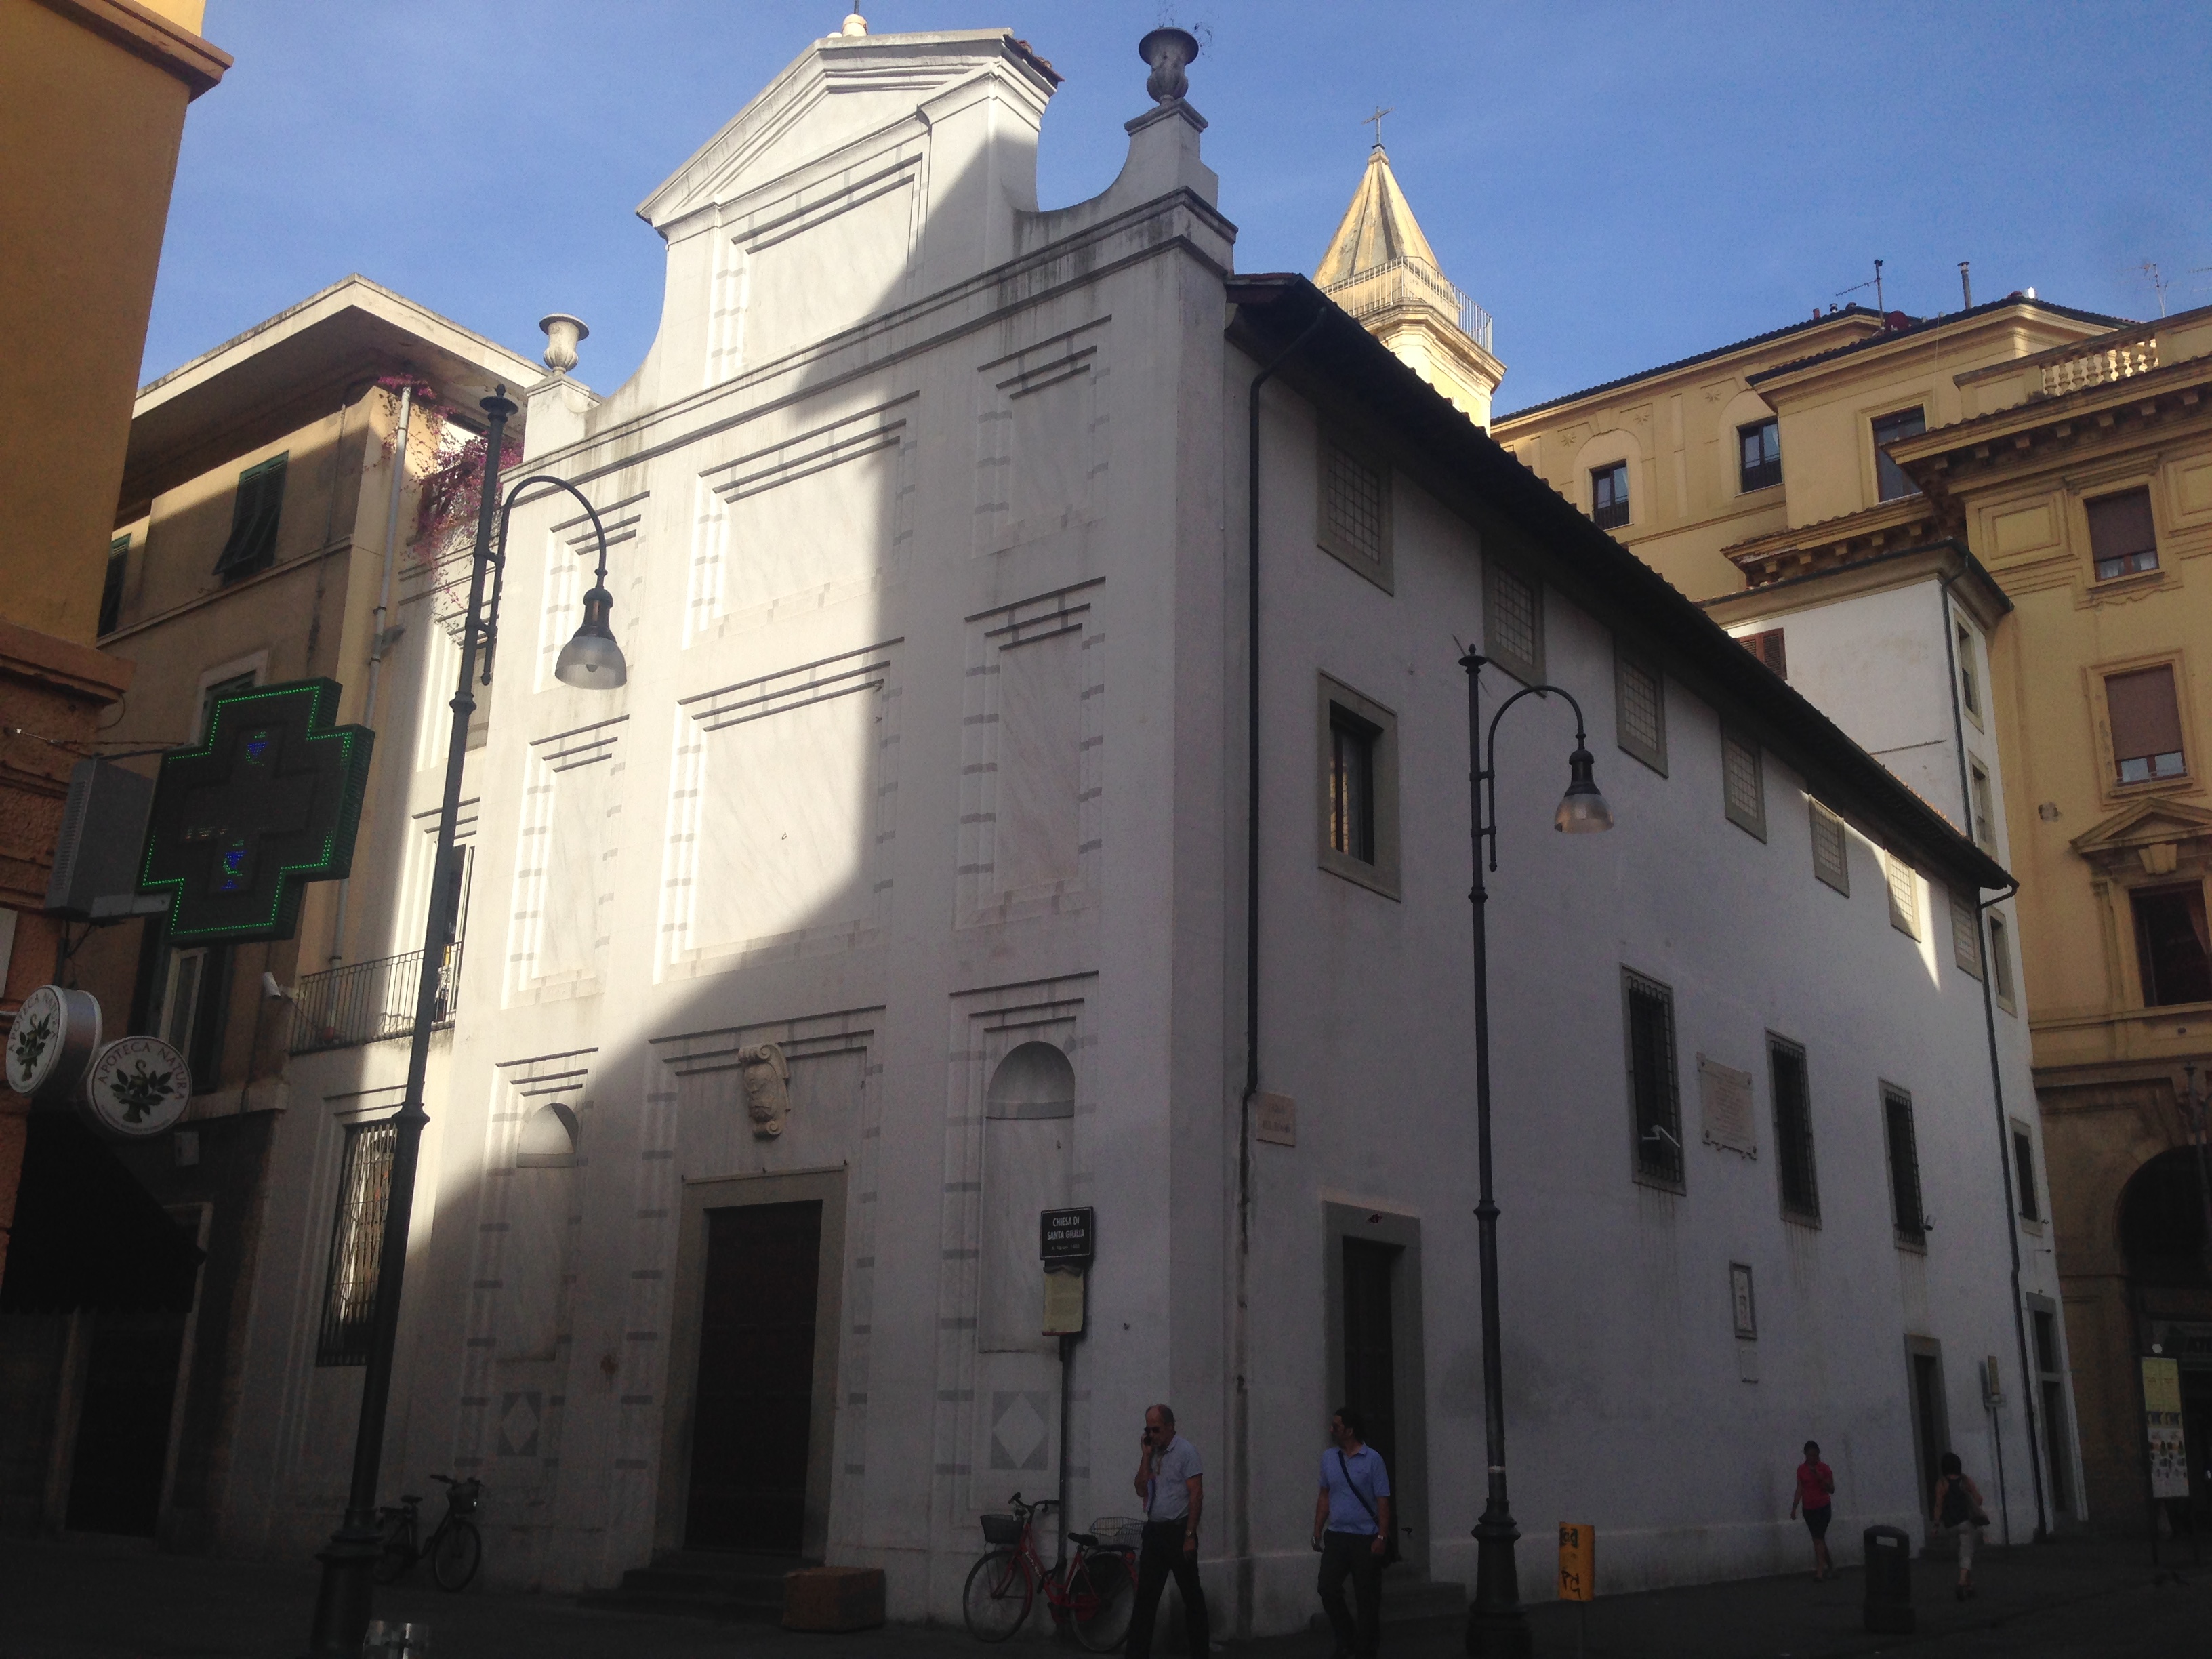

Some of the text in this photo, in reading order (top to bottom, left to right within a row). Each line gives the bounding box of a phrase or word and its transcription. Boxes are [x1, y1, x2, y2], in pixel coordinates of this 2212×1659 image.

[98, 1042, 187, 1099] APOTECA NATURA
[1052, 1215, 1080, 1227] CHIESA DI
[1047, 1229, 1085, 1240] SANTA GIULIA
